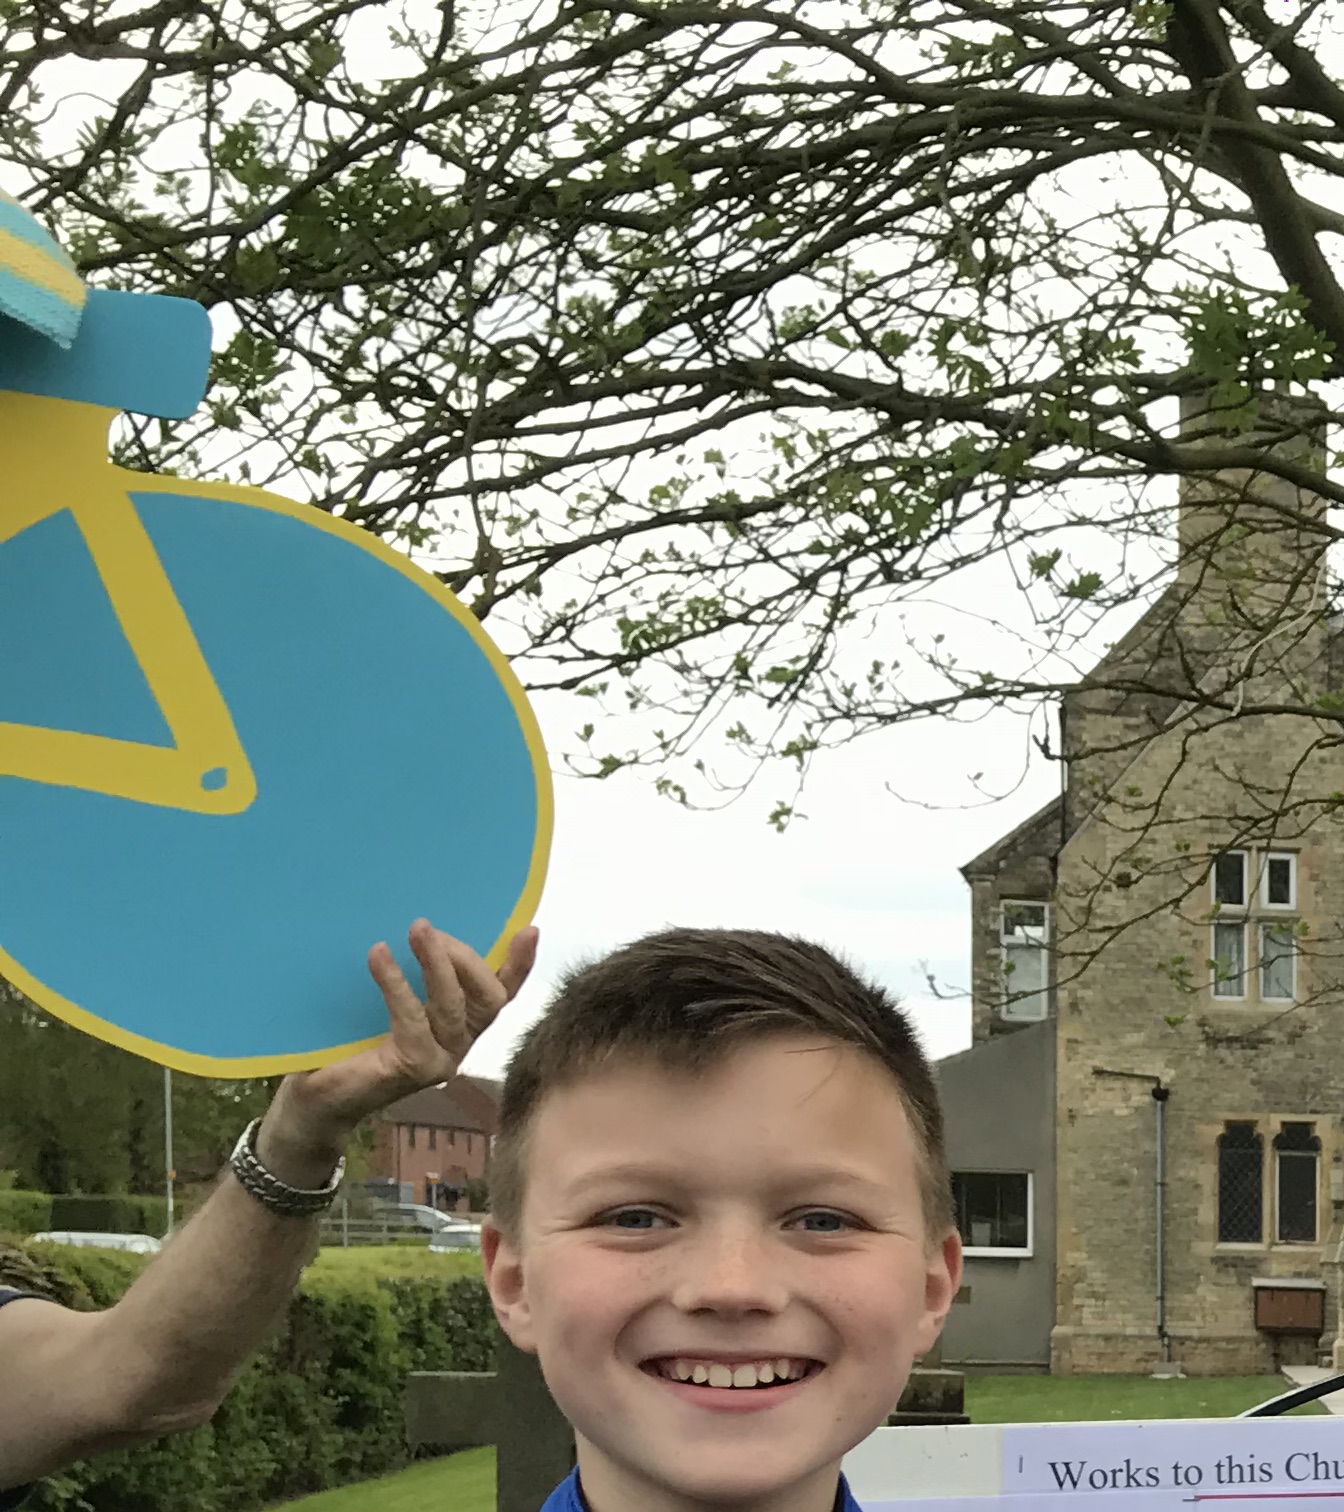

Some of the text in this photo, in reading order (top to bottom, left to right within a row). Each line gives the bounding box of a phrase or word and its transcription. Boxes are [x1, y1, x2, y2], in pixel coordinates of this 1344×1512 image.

[1048, 1457, 1160, 1491] Works
[1173, 1460, 1201, 1486] to
[1215, 1453, 1273, 1484] this
